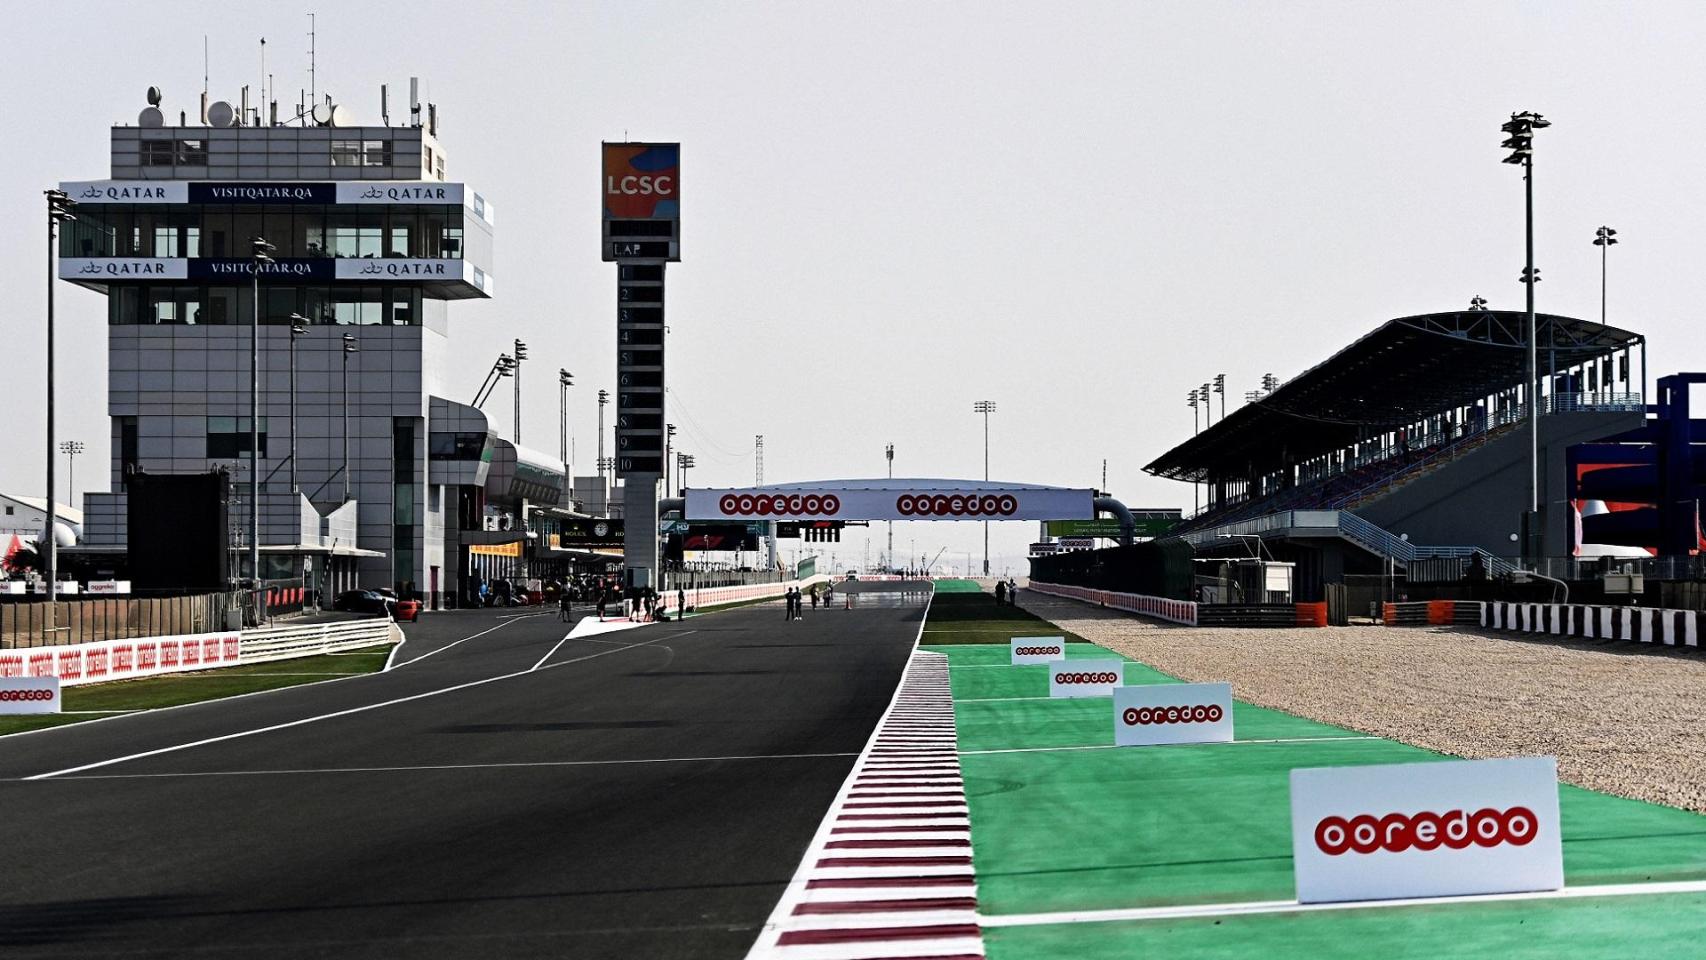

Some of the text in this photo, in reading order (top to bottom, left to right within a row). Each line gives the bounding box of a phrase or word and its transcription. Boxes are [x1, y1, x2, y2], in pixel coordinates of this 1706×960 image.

[607, 175, 672, 195] LCSC
[107, 187, 165, 200] QATAR
[212, 187, 312, 199] VISITQATAR.QA
[388, 187, 445, 200] QATAR
[614, 244, 641, 255] LAP
[106, 263, 165, 275] QATAR
[387, 263, 445, 276] QATAR
[621, 288, 629, 300] 2
[621, 331, 629, 343] 4
[621, 352, 629, 364] 5
[621, 374, 628, 385] 6
[621, 394, 628, 406] 7
[620, 415, 628, 427] 8
[620, 436, 628, 448] 9
[621, 458, 632, 470] 10
[721, 495, 839, 514] ooredoo
[898, 495, 1016, 514] ooredoo
[1016, 646, 1060, 654] ooredoo
[1056, 673, 1117, 683] ooredoo
[0, 691, 53, 700] oredoo
[1124, 706, 1222, 724] ooredoo
[1316, 808, 1536, 853] ooredoo
